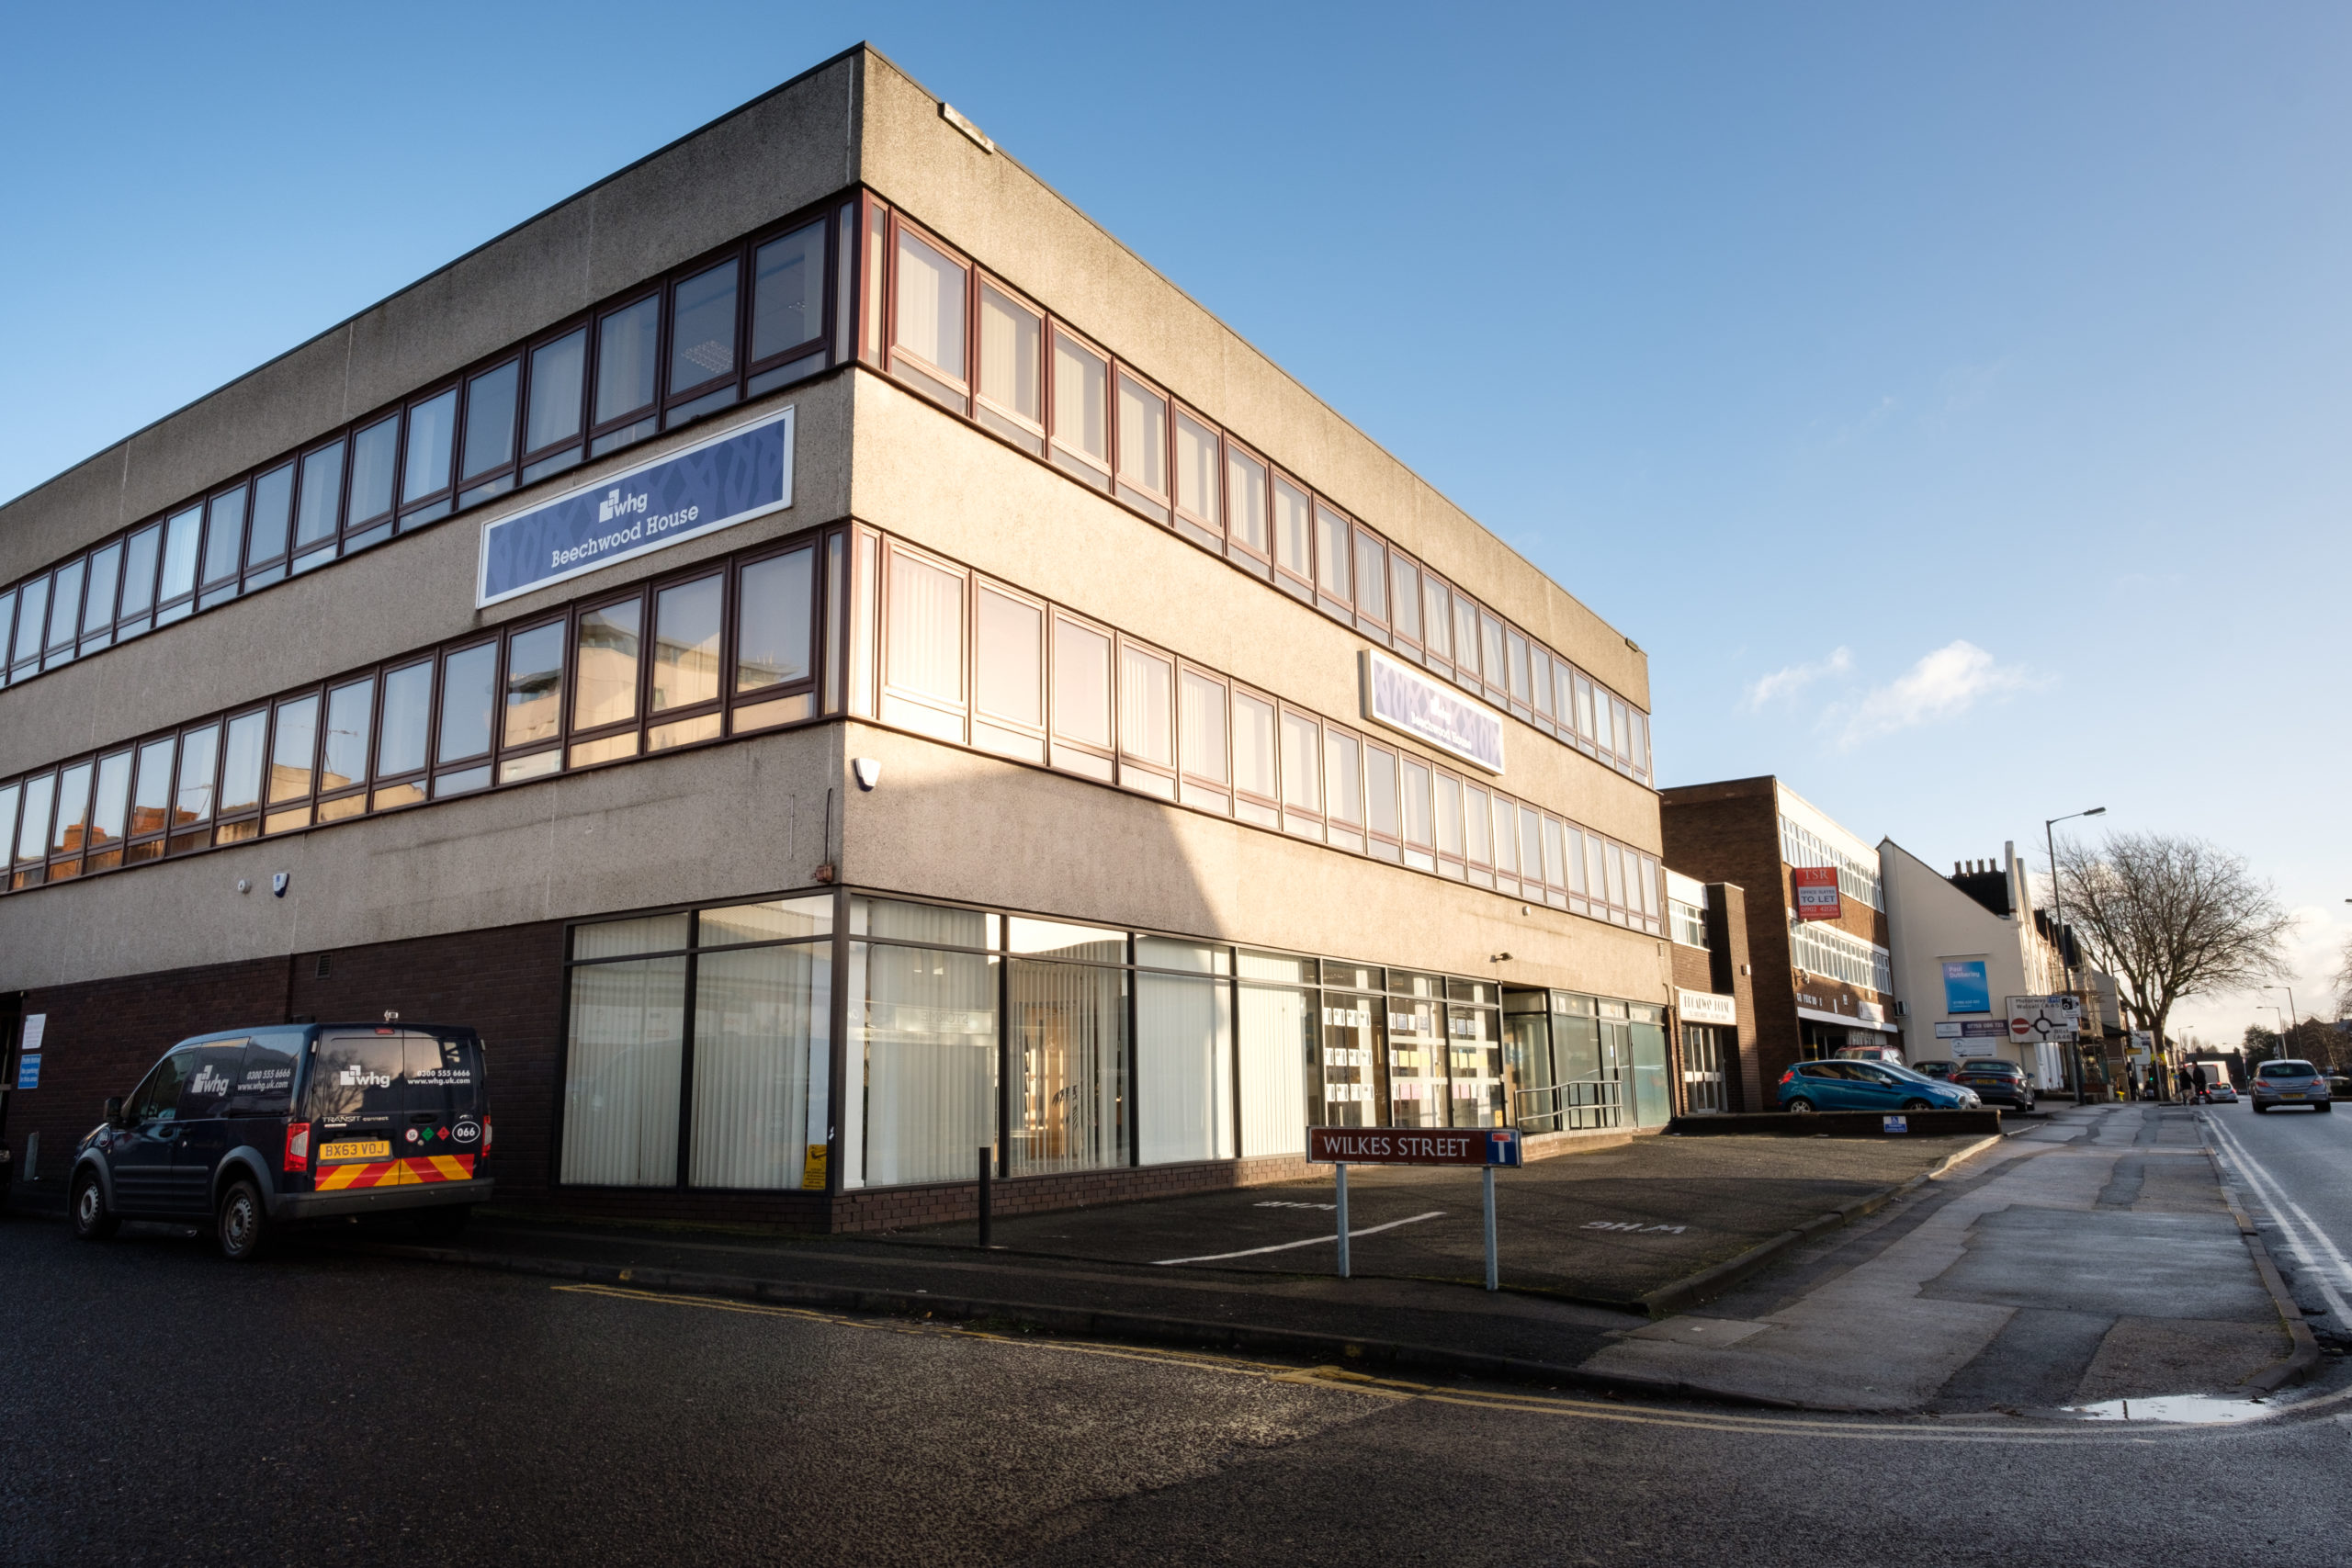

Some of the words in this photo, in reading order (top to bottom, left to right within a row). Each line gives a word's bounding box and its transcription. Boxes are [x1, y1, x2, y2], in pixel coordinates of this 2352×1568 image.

[614, 492, 648, 517] whg
[551, 522, 641, 568] Beechwood
[646, 505, 699, 536] House
[1803, 869, 1829, 880] TSR
[247, 1071, 262, 1079] 0300
[263, 1070, 275, 1079] 555
[275, 1068, 291, 1078] 6666
[356, 1072, 390, 1088] whg
[203, 1073, 229, 1097] whg
[237, 1080, 288, 1091] www.whg.uk.com
[458, 1127, 475, 1137] 066
[325, 1145, 357, 1156] BX63
[361, 1143, 384, 1154] VOJ
[1323, 1136, 1391, 1156] WILKES
[1397, 1138, 1470, 1157] STREET
